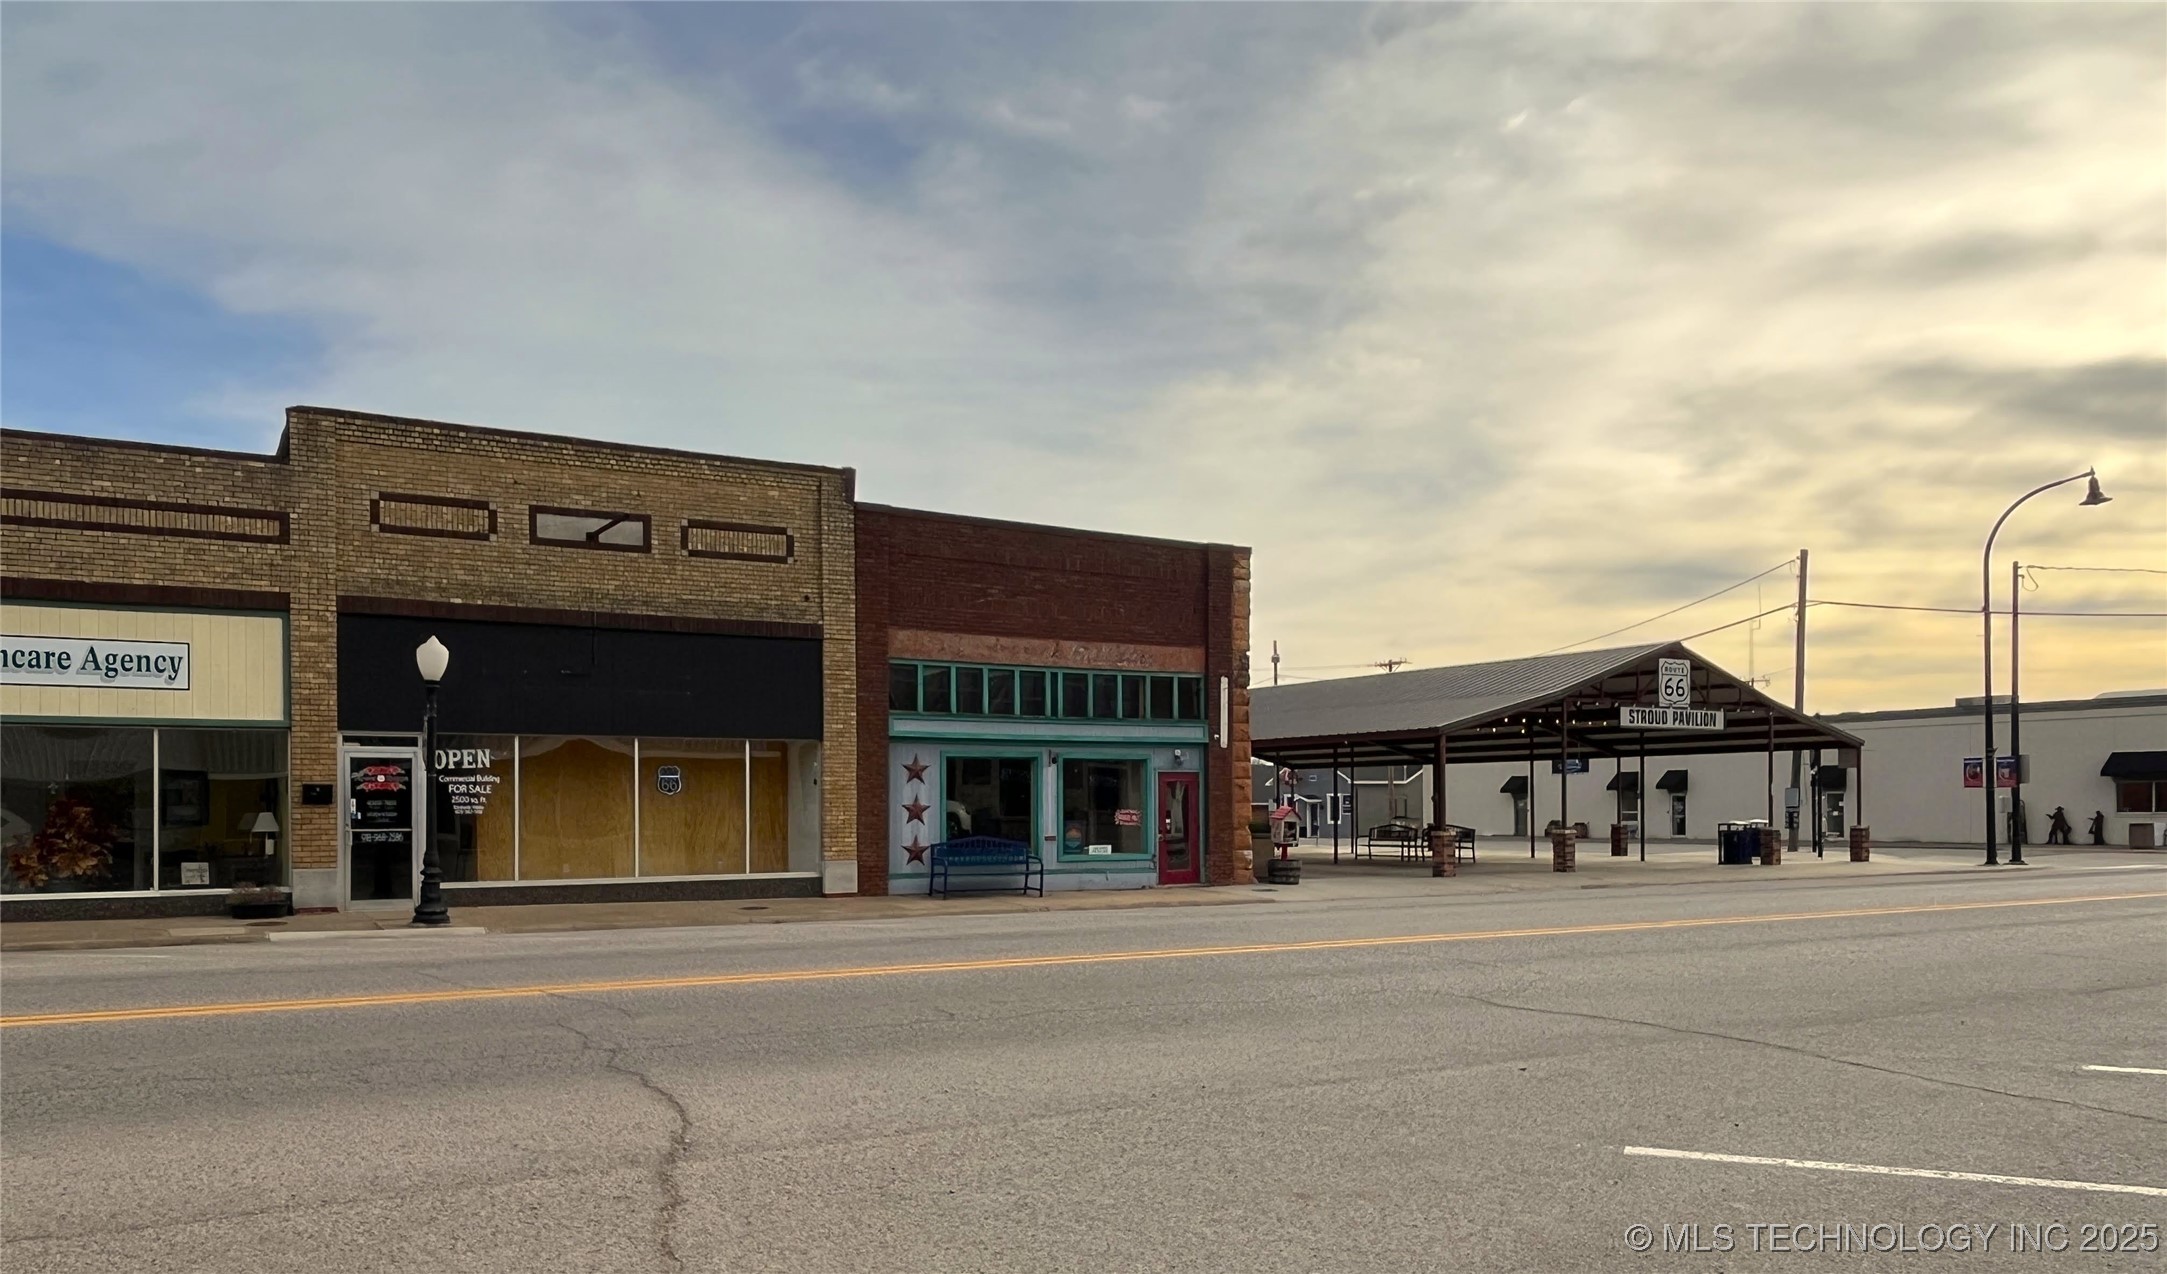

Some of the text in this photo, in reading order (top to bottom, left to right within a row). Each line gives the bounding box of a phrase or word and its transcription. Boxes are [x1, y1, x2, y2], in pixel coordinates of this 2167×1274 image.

[80, 646, 183, 681] Agency
[1664, 666, 1685, 674] ROUTE
[1664, 677, 1686, 697] 66
[1628, 709, 1717, 728] STROUD PAVILION
[434, 748, 491, 770] OPEN
[438, 774, 500, 784] Commercial Building
[661, 777, 678, 791] 66
[448, 784, 492, 794] FOR SALE
[451, 795, 470, 804] 2500
